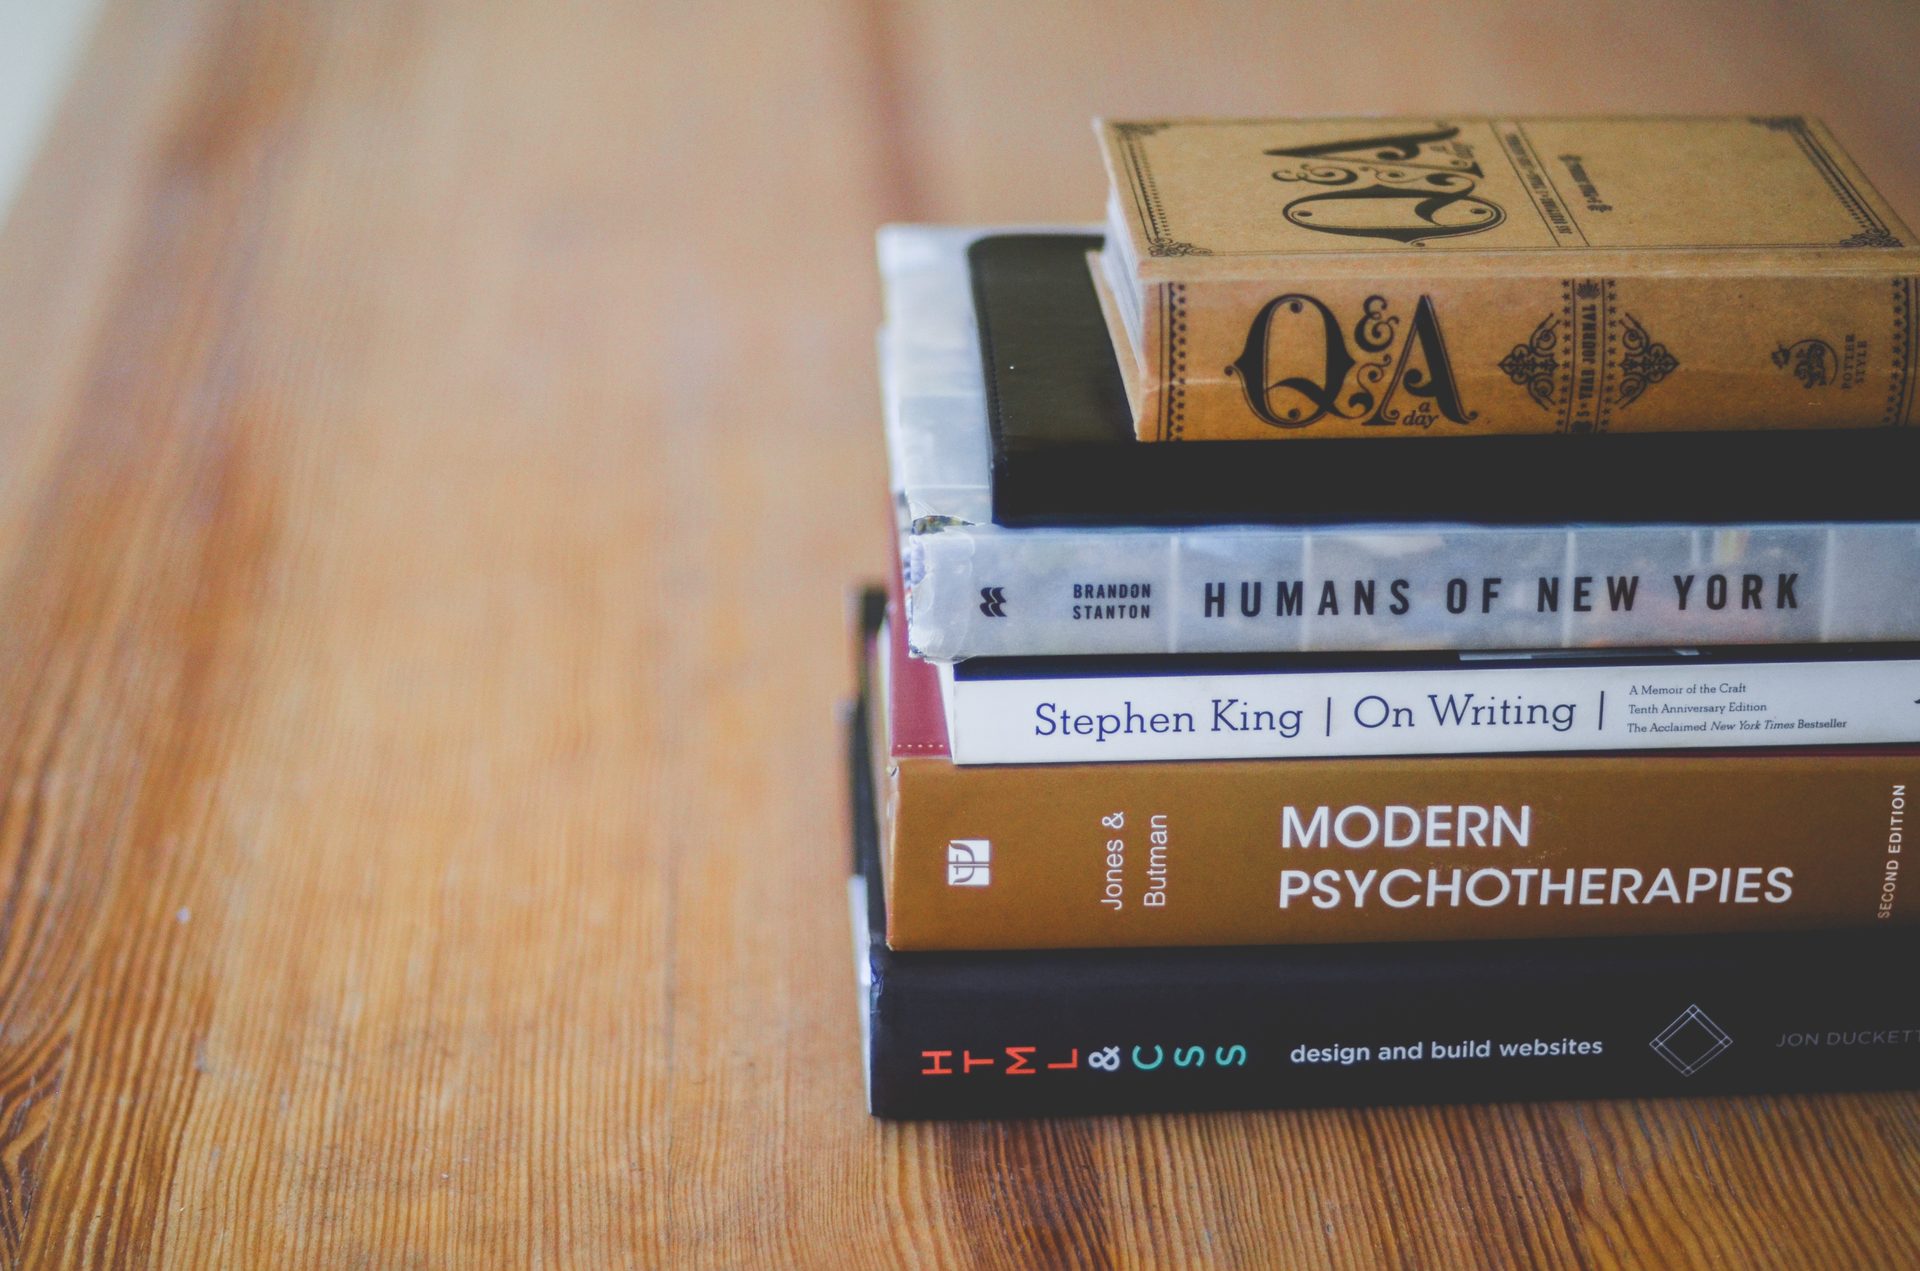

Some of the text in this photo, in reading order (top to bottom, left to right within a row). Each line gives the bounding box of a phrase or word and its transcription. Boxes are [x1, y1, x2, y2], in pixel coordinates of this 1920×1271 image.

[1581, 304, 1597, 365] JOURNAL
[1224, 293, 1478, 428] Q&A
[1841, 333, 1856, 390] POTTER
[1856, 340, 1869, 384] STYLE
[1402, 409, 1439, 428] day
[1417, 401, 1431, 414] a
[1072, 604, 1150, 620] STANTON
[1073, 583, 1151, 599] BRANDON
[1204, 573, 1799, 618] HUMANS OF NEW YORK
[1628, 682, 1746, 696] A Memoir of the Craft
[1628, 702, 1767, 715] Tenth Anniversary Edition
[1035, 698, 1303, 742] Stephen King
[1354, 693, 1577, 731] On Writing
[1626, 718, 1848, 733] The Acclaimed New York Times Bestseller
[1281, 804, 1531, 849] MODERN
[1101, 811, 1125, 911] Jones &
[1143, 814, 1168, 907] Butman
[1877, 784, 1906, 918] SECOND EDITION
[1279, 866, 1794, 910] PSYCHOTHERAPIES
[1290, 1037, 1603, 1065] design and build websites
[1776, 1032, 1820, 1048] JON
